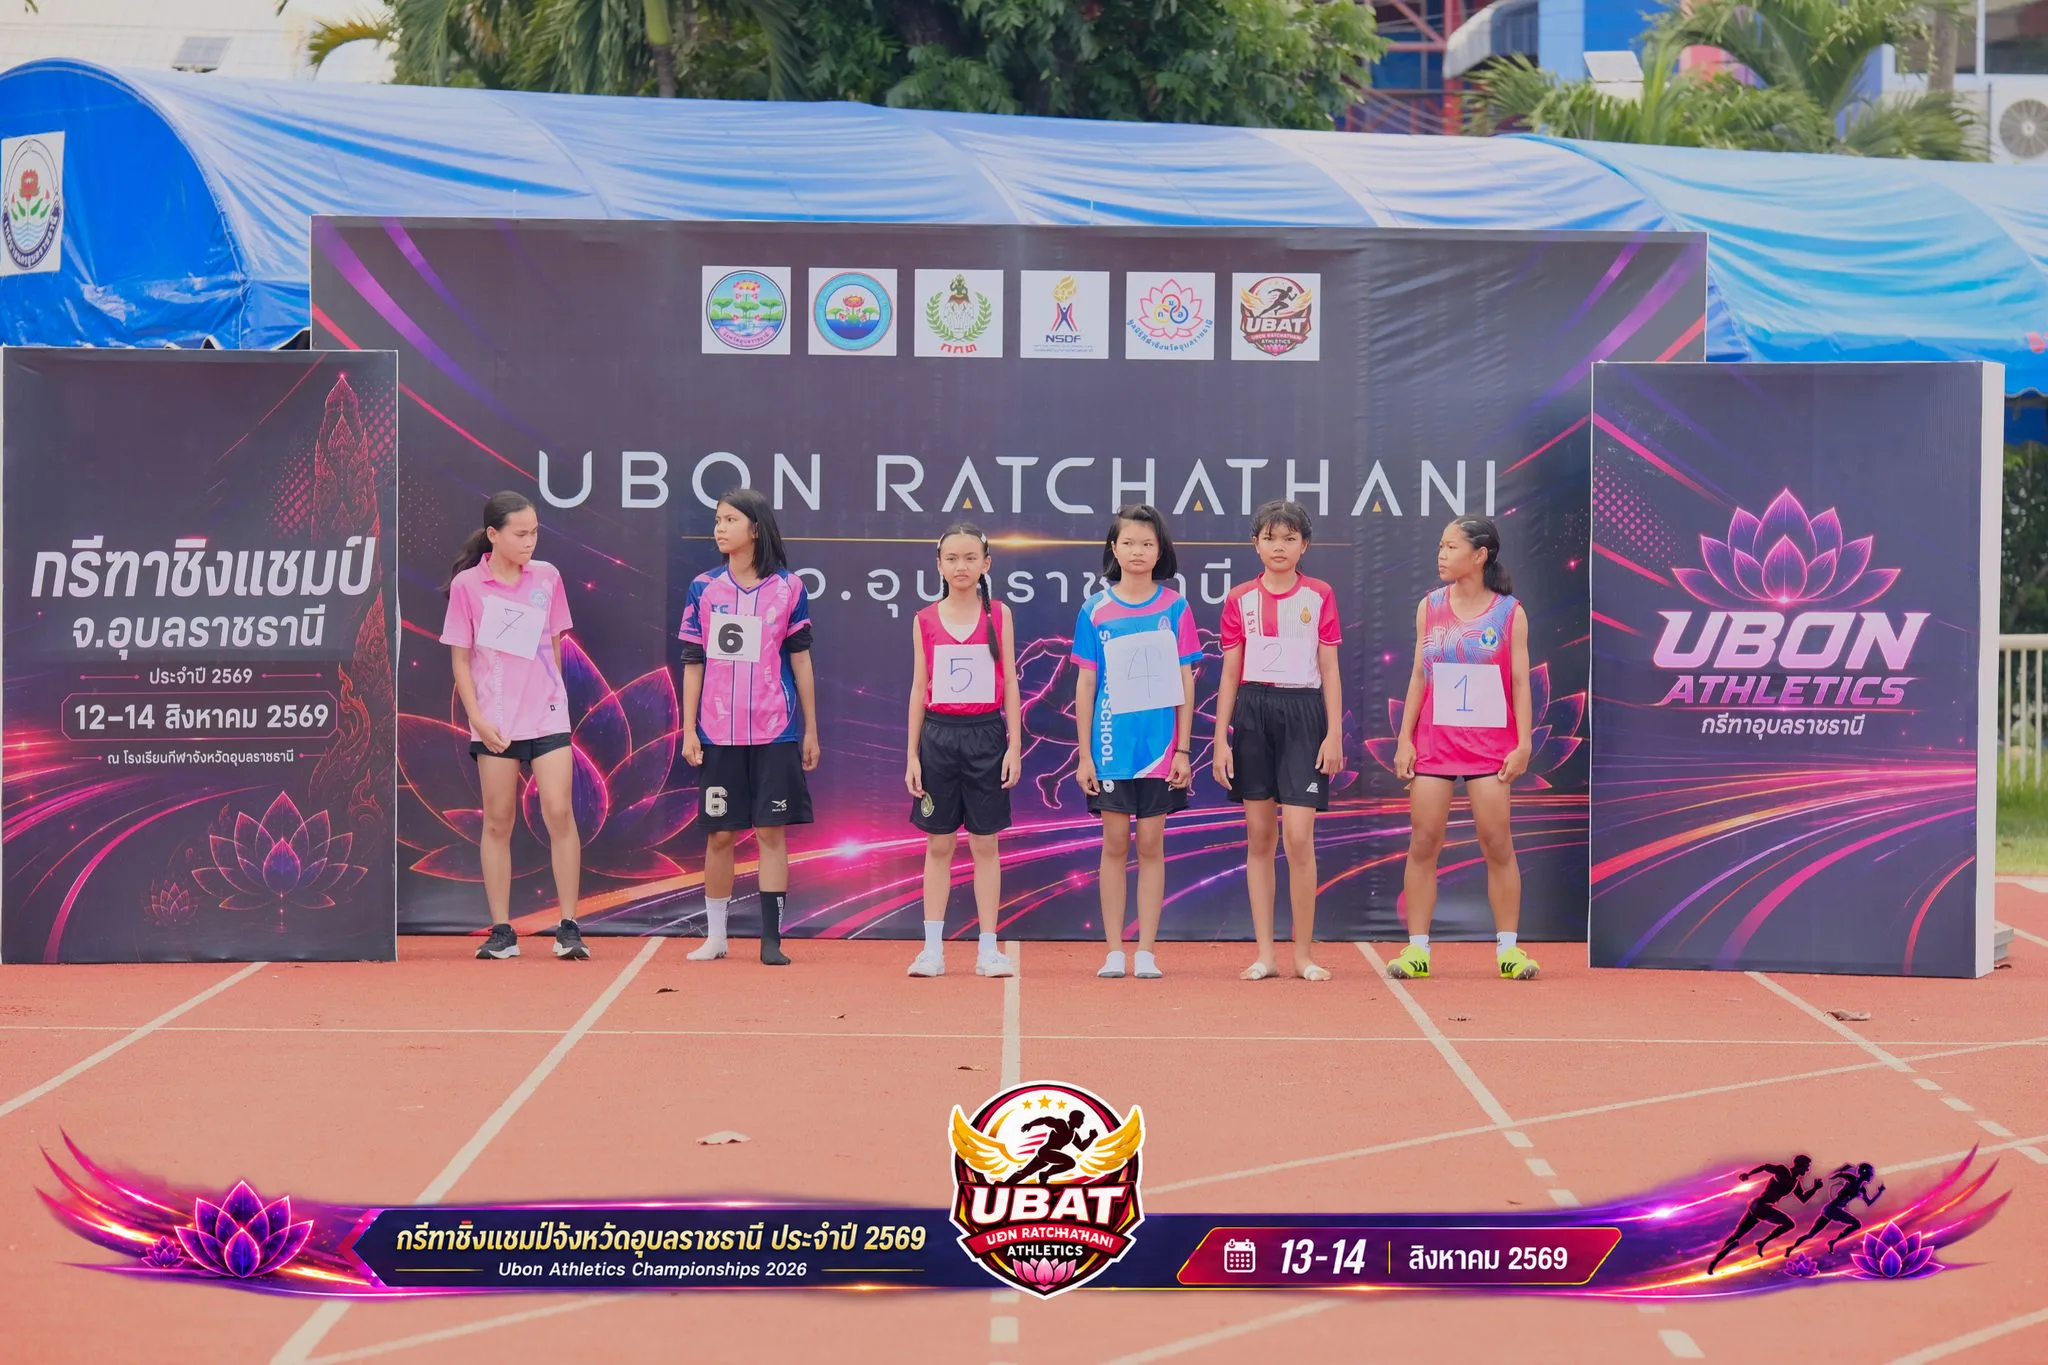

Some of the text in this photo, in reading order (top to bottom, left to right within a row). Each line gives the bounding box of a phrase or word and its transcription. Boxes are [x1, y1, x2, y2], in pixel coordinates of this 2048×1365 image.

[1045, 334, 1081, 343] NSDF
[1246, 317, 1307, 334] UBAT
[538, 450, 1496, 517] UBON RATCHATHANI
[31, 535, 377, 599] กรีฑาชิงแชมป์
[72, 603, 327, 662] จ.อุบลราชธานี
[496, 607, 525, 640] 7
[717, 622, 744, 654] 6
[1653, 611, 1932, 670] UBON
[1127, 646, 1161, 699] 4
[1262, 642, 1286, 673] 2
[149, 666, 253, 685] ประจำปี 2569
[950, 657, 974, 693] 5
[1652, 675, 1920, 706] ATHLETICS
[1453, 674, 1475, 712] 1
[165, 703, 258, 730] สิงหาคม
[266, 703, 329, 729] 2569
[1101, 697, 1114, 766] SCHOOL
[1701, 712, 1866, 741] กรีฑาอุบลราชธานี
[107, 748, 294, 767] ณ โรงเรียนกีฬาจังหวัดอุบลราชธานี
[705, 786, 728, 817] 6
